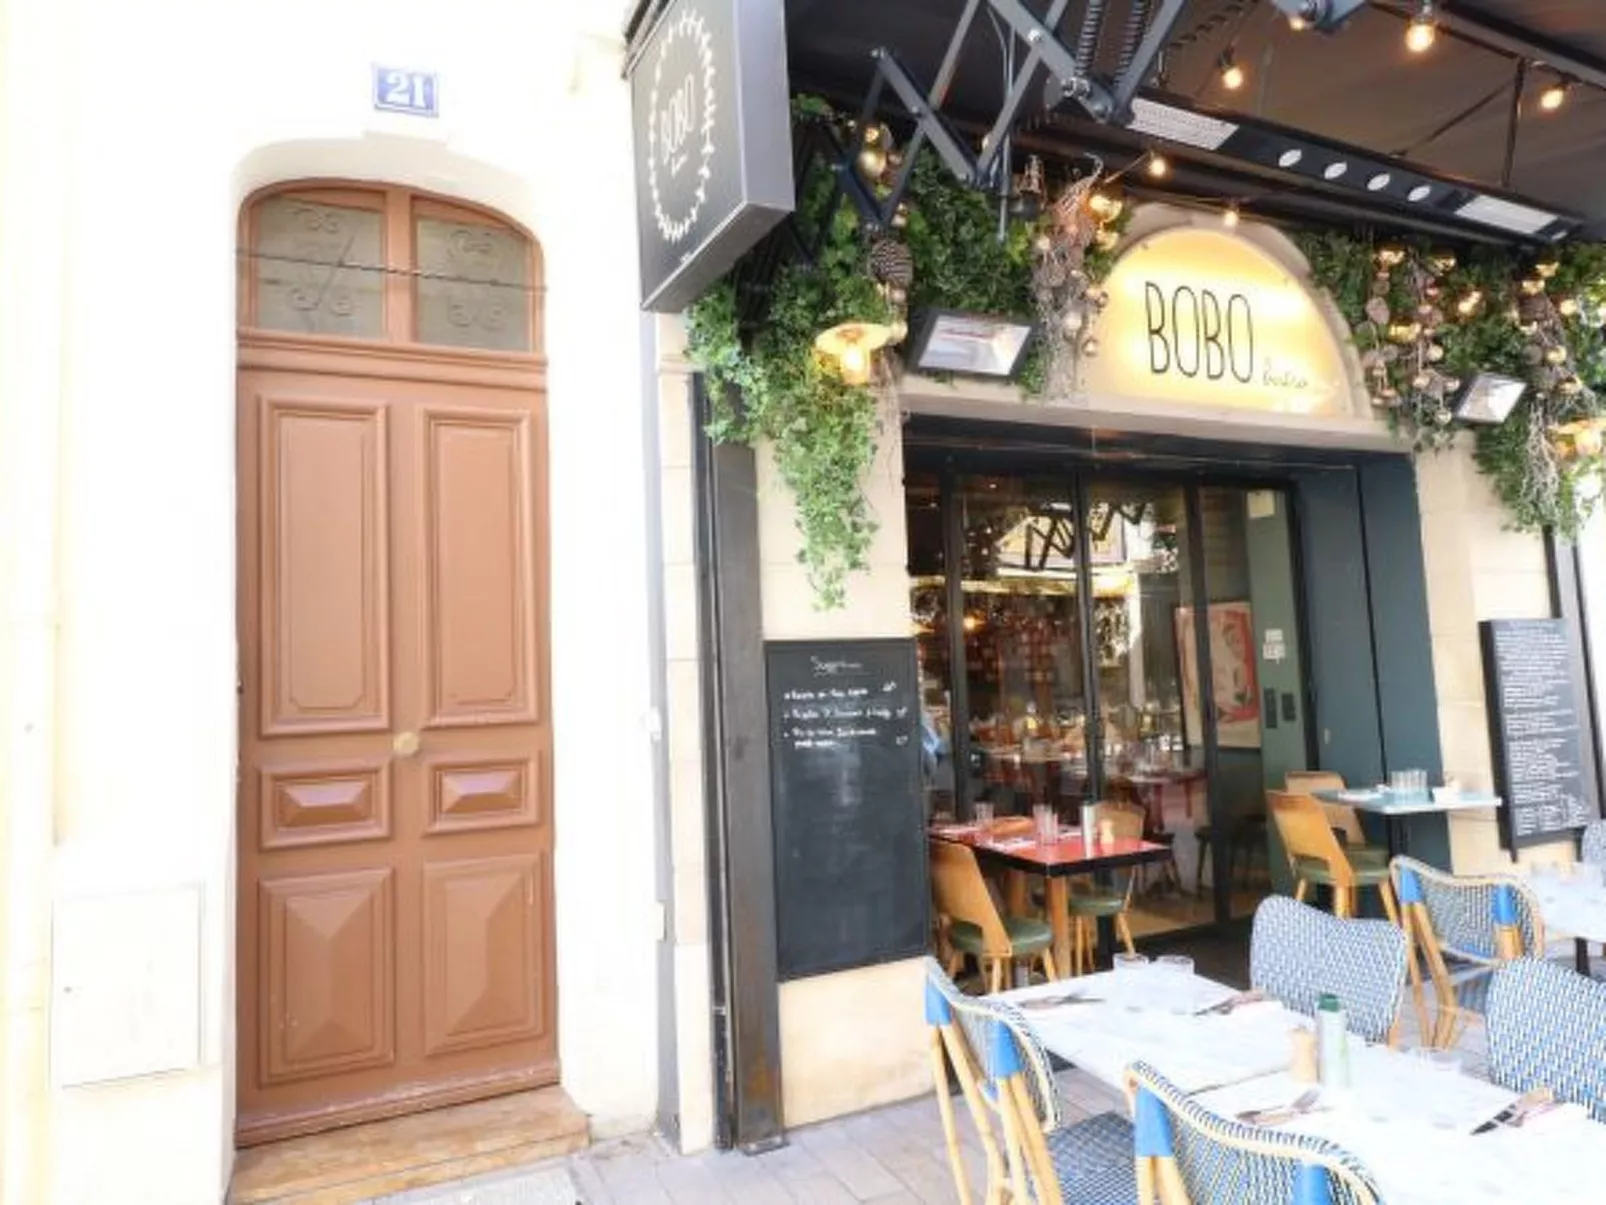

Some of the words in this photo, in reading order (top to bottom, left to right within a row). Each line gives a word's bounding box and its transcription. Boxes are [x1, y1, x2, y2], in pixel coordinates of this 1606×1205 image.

[386, 70, 427, 108] 21
[660, 73, 697, 166] BOBO
[1145, 281, 1254, 384] BOBO
